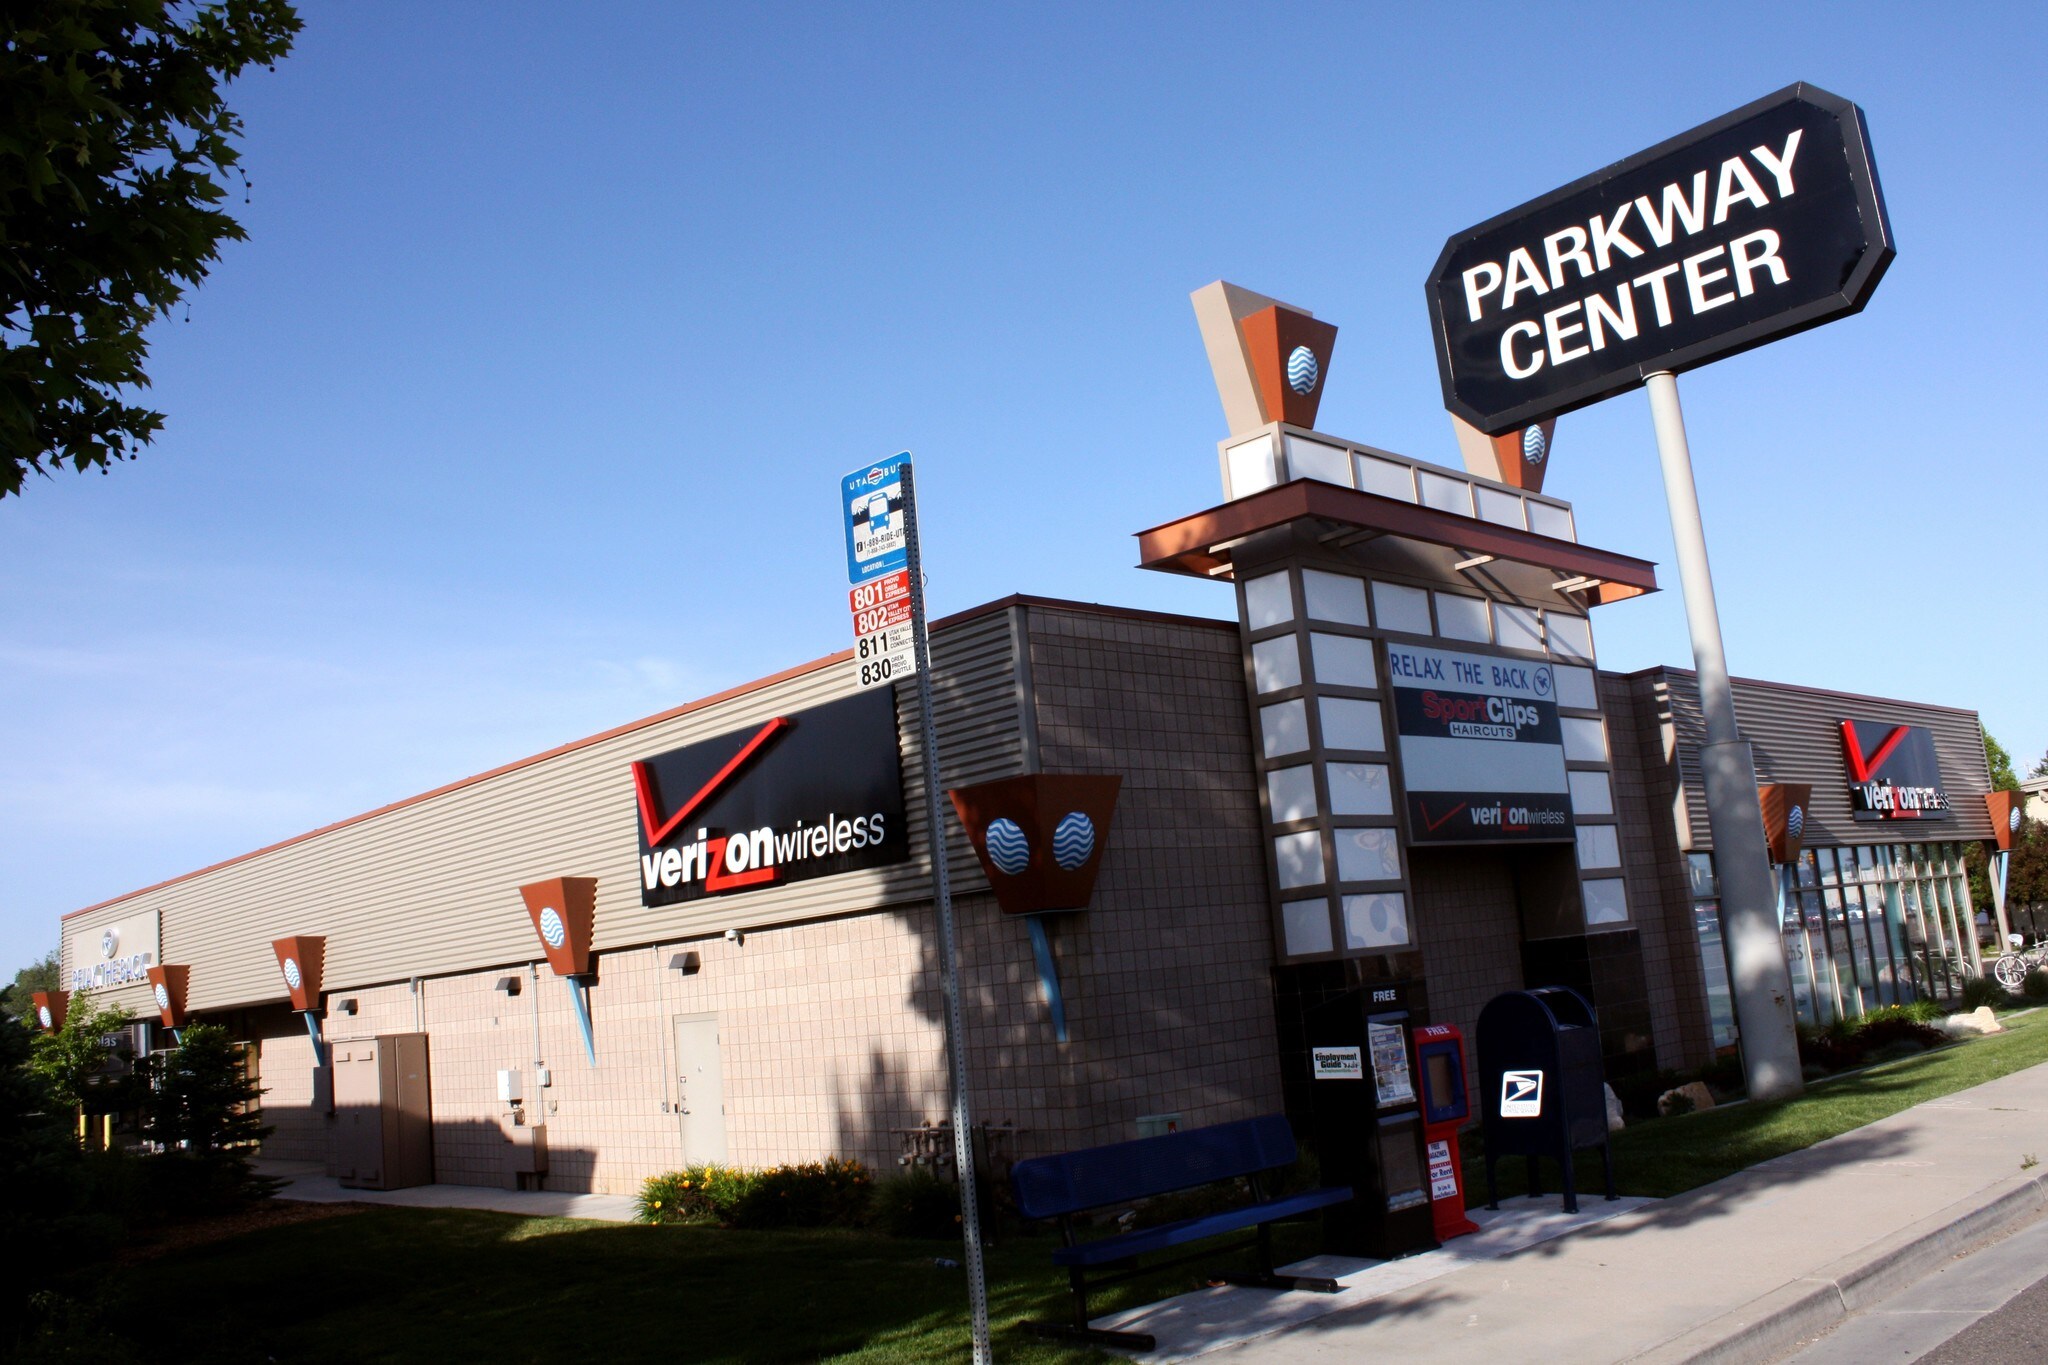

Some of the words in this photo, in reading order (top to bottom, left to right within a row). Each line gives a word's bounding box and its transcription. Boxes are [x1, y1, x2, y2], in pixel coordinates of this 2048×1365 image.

[1462, 128, 1803, 323] PARKWAY
[1500, 227, 1791, 380] CENTER
[849, 478, 868, 490] UTA
[854, 581, 884, 610] 801
[858, 606, 888, 634] 802
[859, 632, 888, 659] 811
[890, 637, 914, 648] CONNECTO
[861, 658, 891, 685] 830
[1390, 653, 1445, 681] RELAX
[1452, 661, 1484, 685] THE
[1491, 666, 1530, 691] BACK
[1452, 725, 1514, 738] HAIRCUTS
[100, 961, 119, 985] THE
[120, 953, 151, 981] BACK
[1373, 989, 1397, 1002] FREE
[1425, 1025, 1450, 1036] FREE
[1315, 1052, 1358, 1061] Employment
[1320, 1060, 1342, 1068] Guide
[1439, 1167, 1452, 1176] Rent
